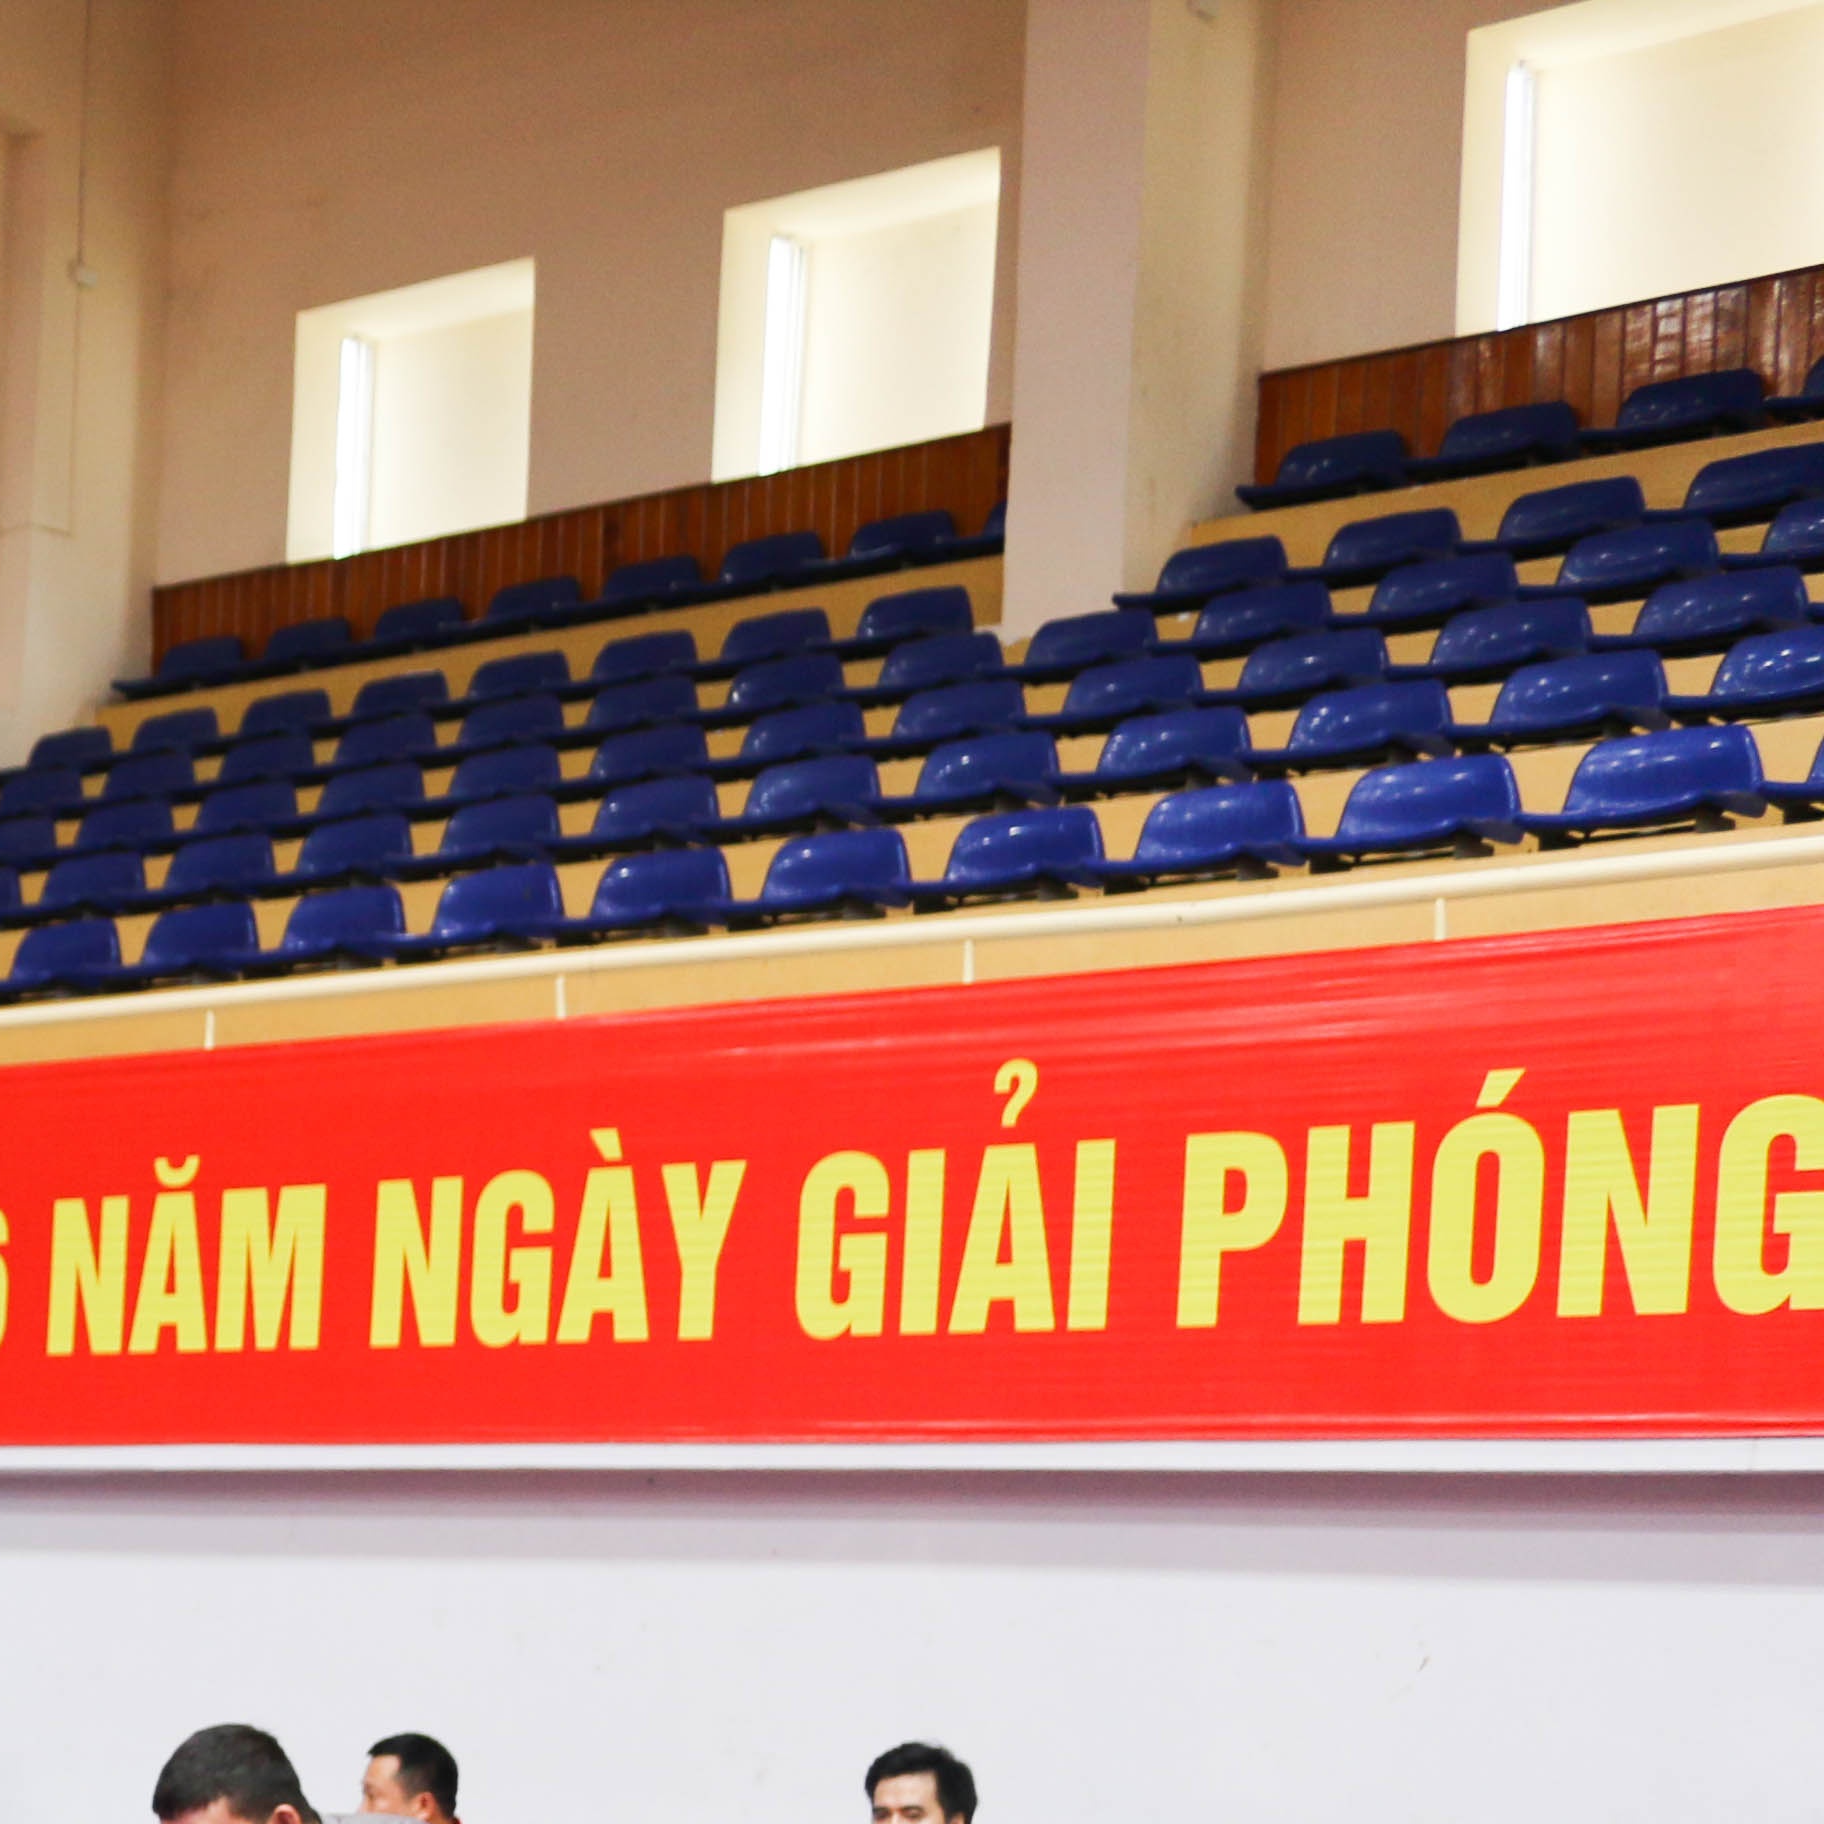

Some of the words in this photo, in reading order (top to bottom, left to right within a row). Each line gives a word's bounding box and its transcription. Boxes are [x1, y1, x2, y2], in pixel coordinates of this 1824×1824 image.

[46, 1154, 328, 1357] NĂM
[370, 1128, 748, 1350] NGÀY
[794, 1059, 1116, 1340] GIẢI
[1175, 1068, 1824, 1329] PHÓNG
